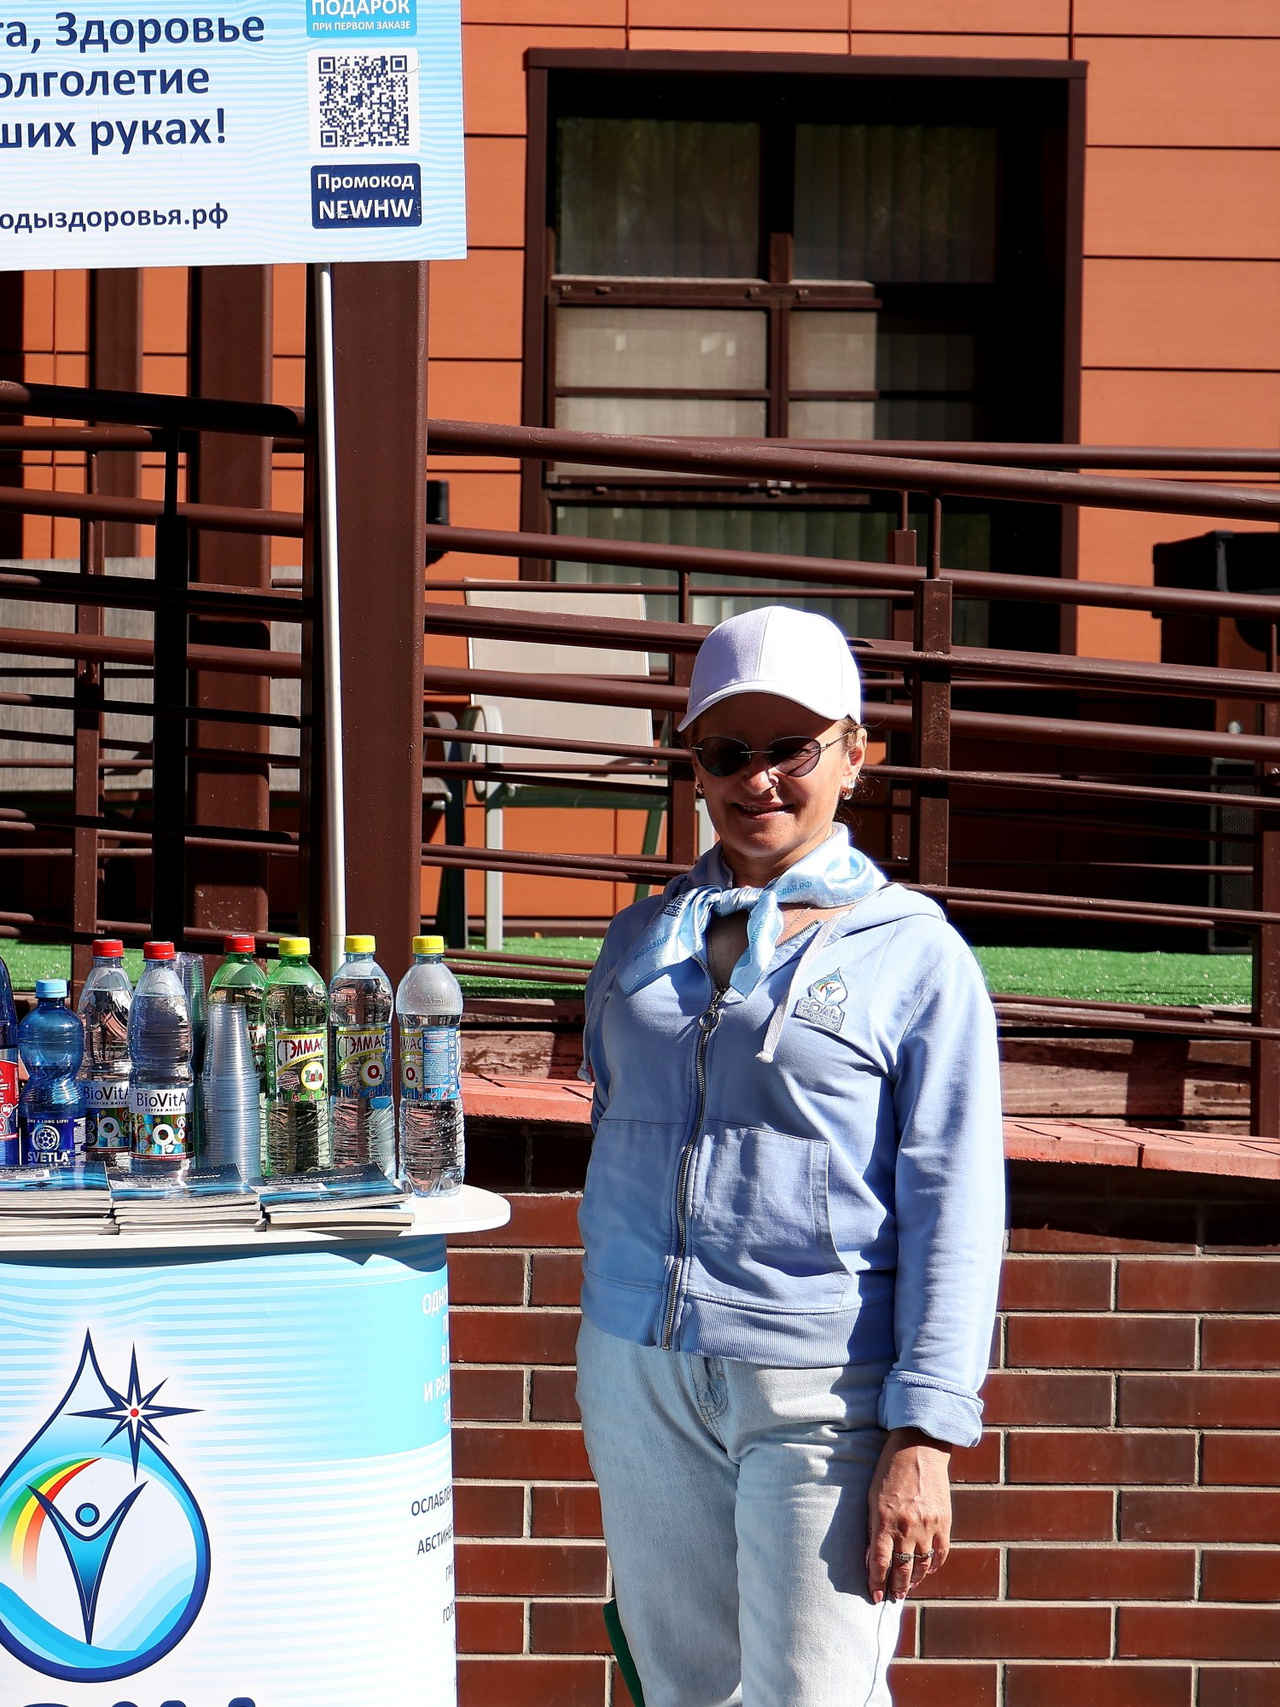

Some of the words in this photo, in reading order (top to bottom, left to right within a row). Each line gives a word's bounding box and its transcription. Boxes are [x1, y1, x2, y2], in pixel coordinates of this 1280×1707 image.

[312, 0, 410, 18] ПОДАРОК
[55, 12, 265, 53] Здоровье
[312, 22, 332, 31] ПРИ
[334, 21, 374, 31] ПЕРВОМ
[376, 20, 411, 30] ЗАКАЗЕ
[89, 108, 227, 156] руках!
[317, 171, 415, 196] Промокод
[318, 198, 413, 219] NEWHW
[27, 1152, 68, 1162] SVETLA
[424, 1380, 433, 1404] И
